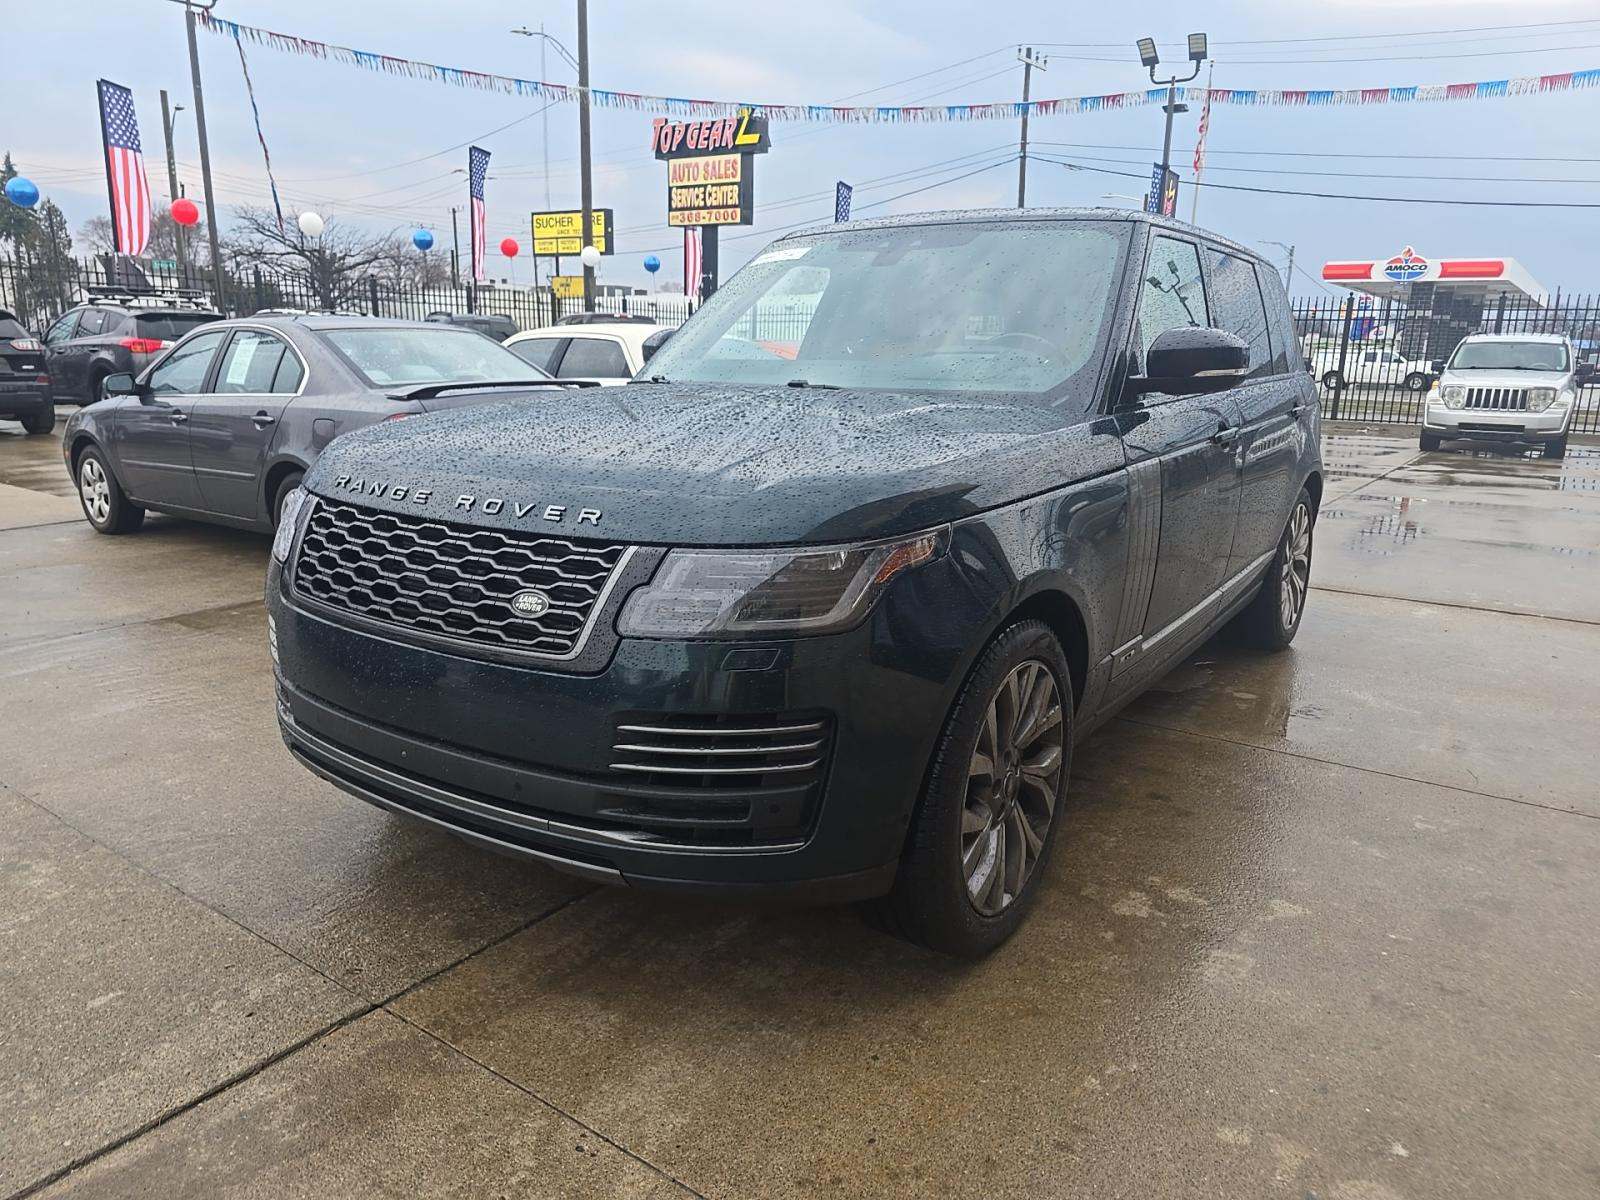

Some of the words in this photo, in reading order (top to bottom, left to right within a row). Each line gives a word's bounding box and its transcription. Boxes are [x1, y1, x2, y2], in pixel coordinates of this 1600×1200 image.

[651, 117, 685, 153] TOP
[671, 161, 700, 183] AUTO
[703, 158, 738, 180] SALES
[671, 187, 705, 209] SERVICE
[705, 184, 739, 207] CENTER
[535, 216, 573, 229] SUCHER
[1385, 264, 1428, 272] AMOCO
[334, 474, 432, 504] RANGE
[454, 494, 603, 525] ROVER
[519, 595, 538, 603] LAND
